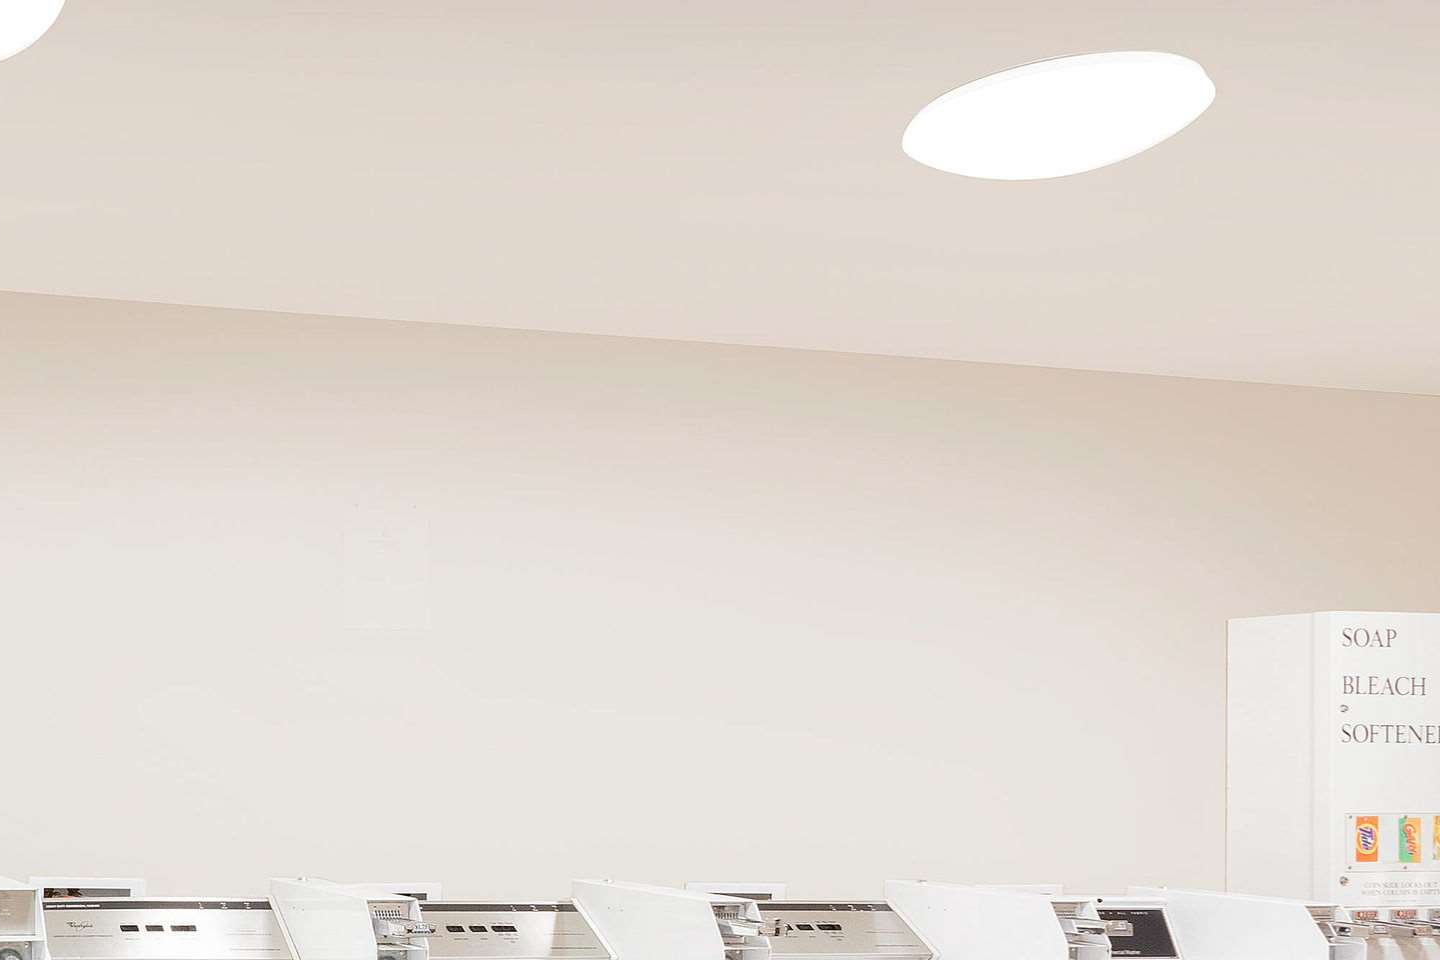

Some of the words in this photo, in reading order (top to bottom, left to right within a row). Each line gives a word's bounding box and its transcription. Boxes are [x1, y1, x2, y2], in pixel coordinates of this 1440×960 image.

[1341, 627, 1397, 648] SOAP
[1342, 675, 1426, 696] BLEACH
[1341, 723, 1440, 744] SOFTENE
